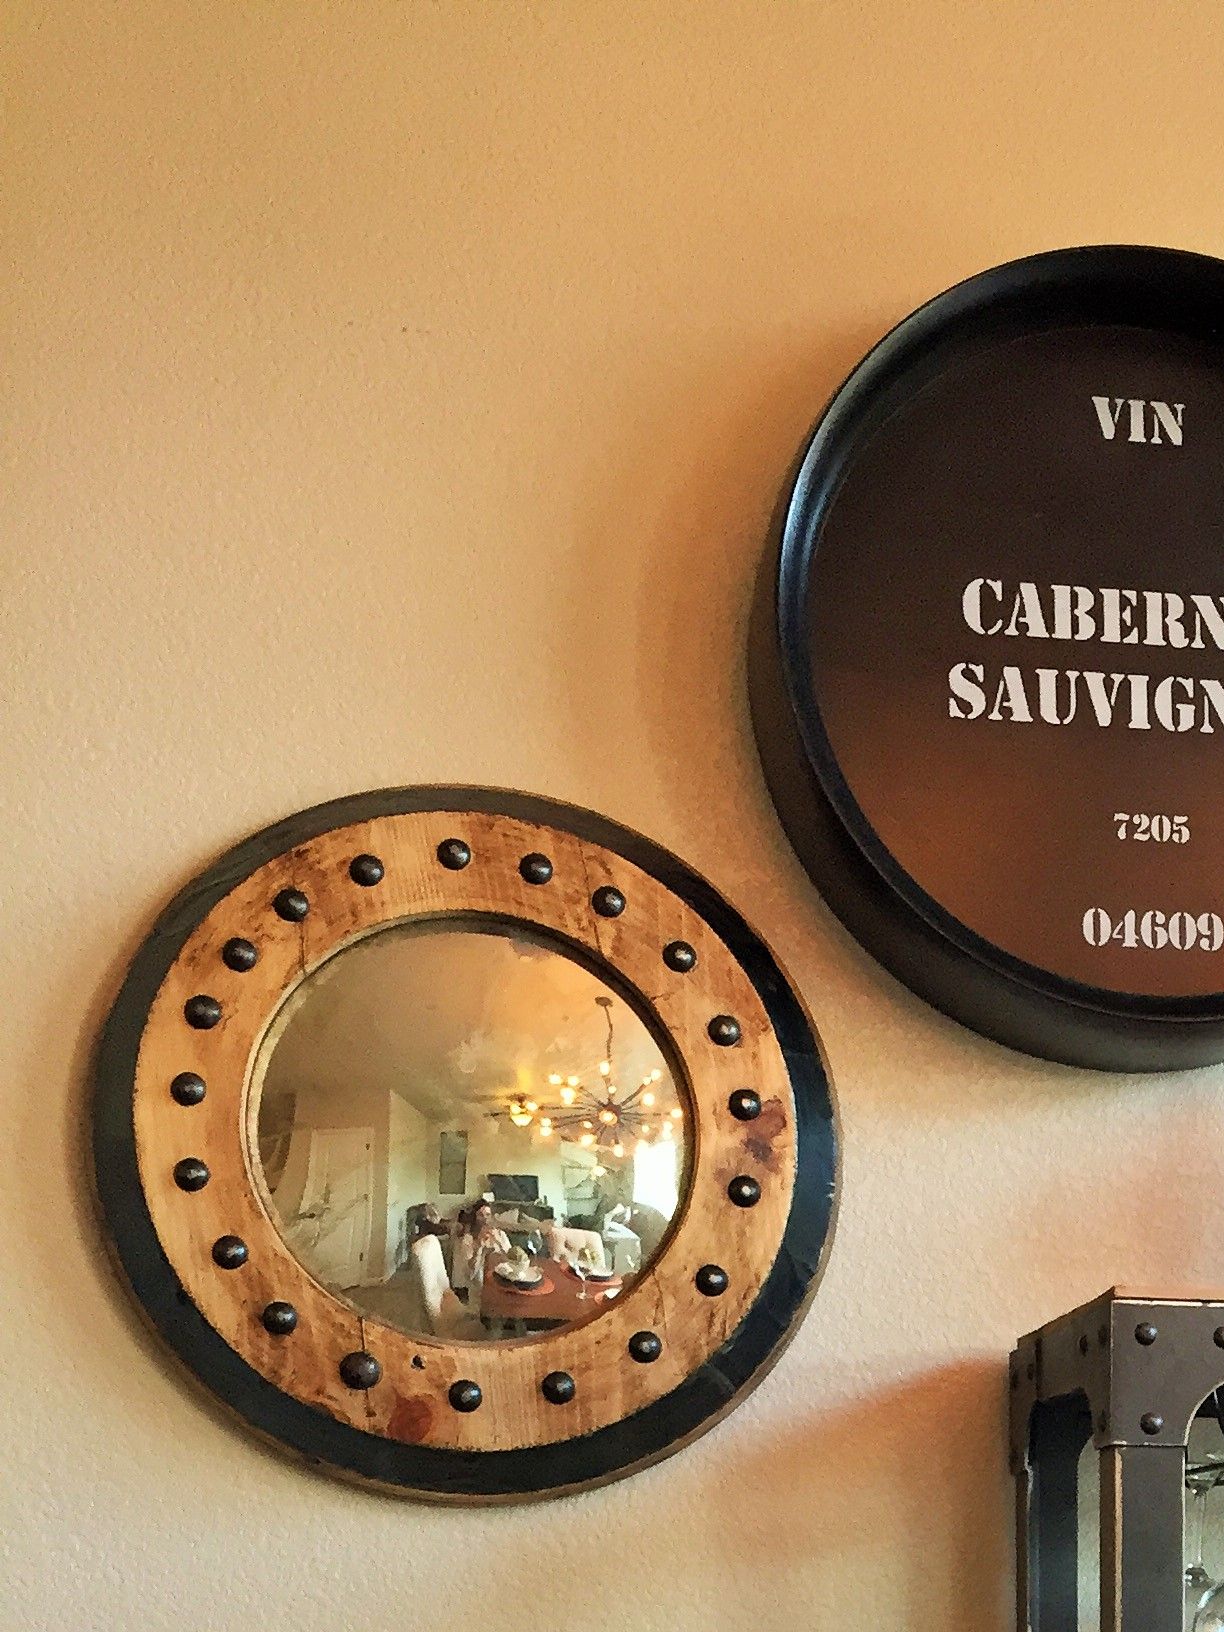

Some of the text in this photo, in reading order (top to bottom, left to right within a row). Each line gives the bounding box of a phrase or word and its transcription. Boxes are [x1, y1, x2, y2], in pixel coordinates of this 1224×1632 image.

[1091, 396, 1186, 446] VIN
[1113, 812, 1191, 844] 7205
[1081, 907, 1224, 952] 04609
